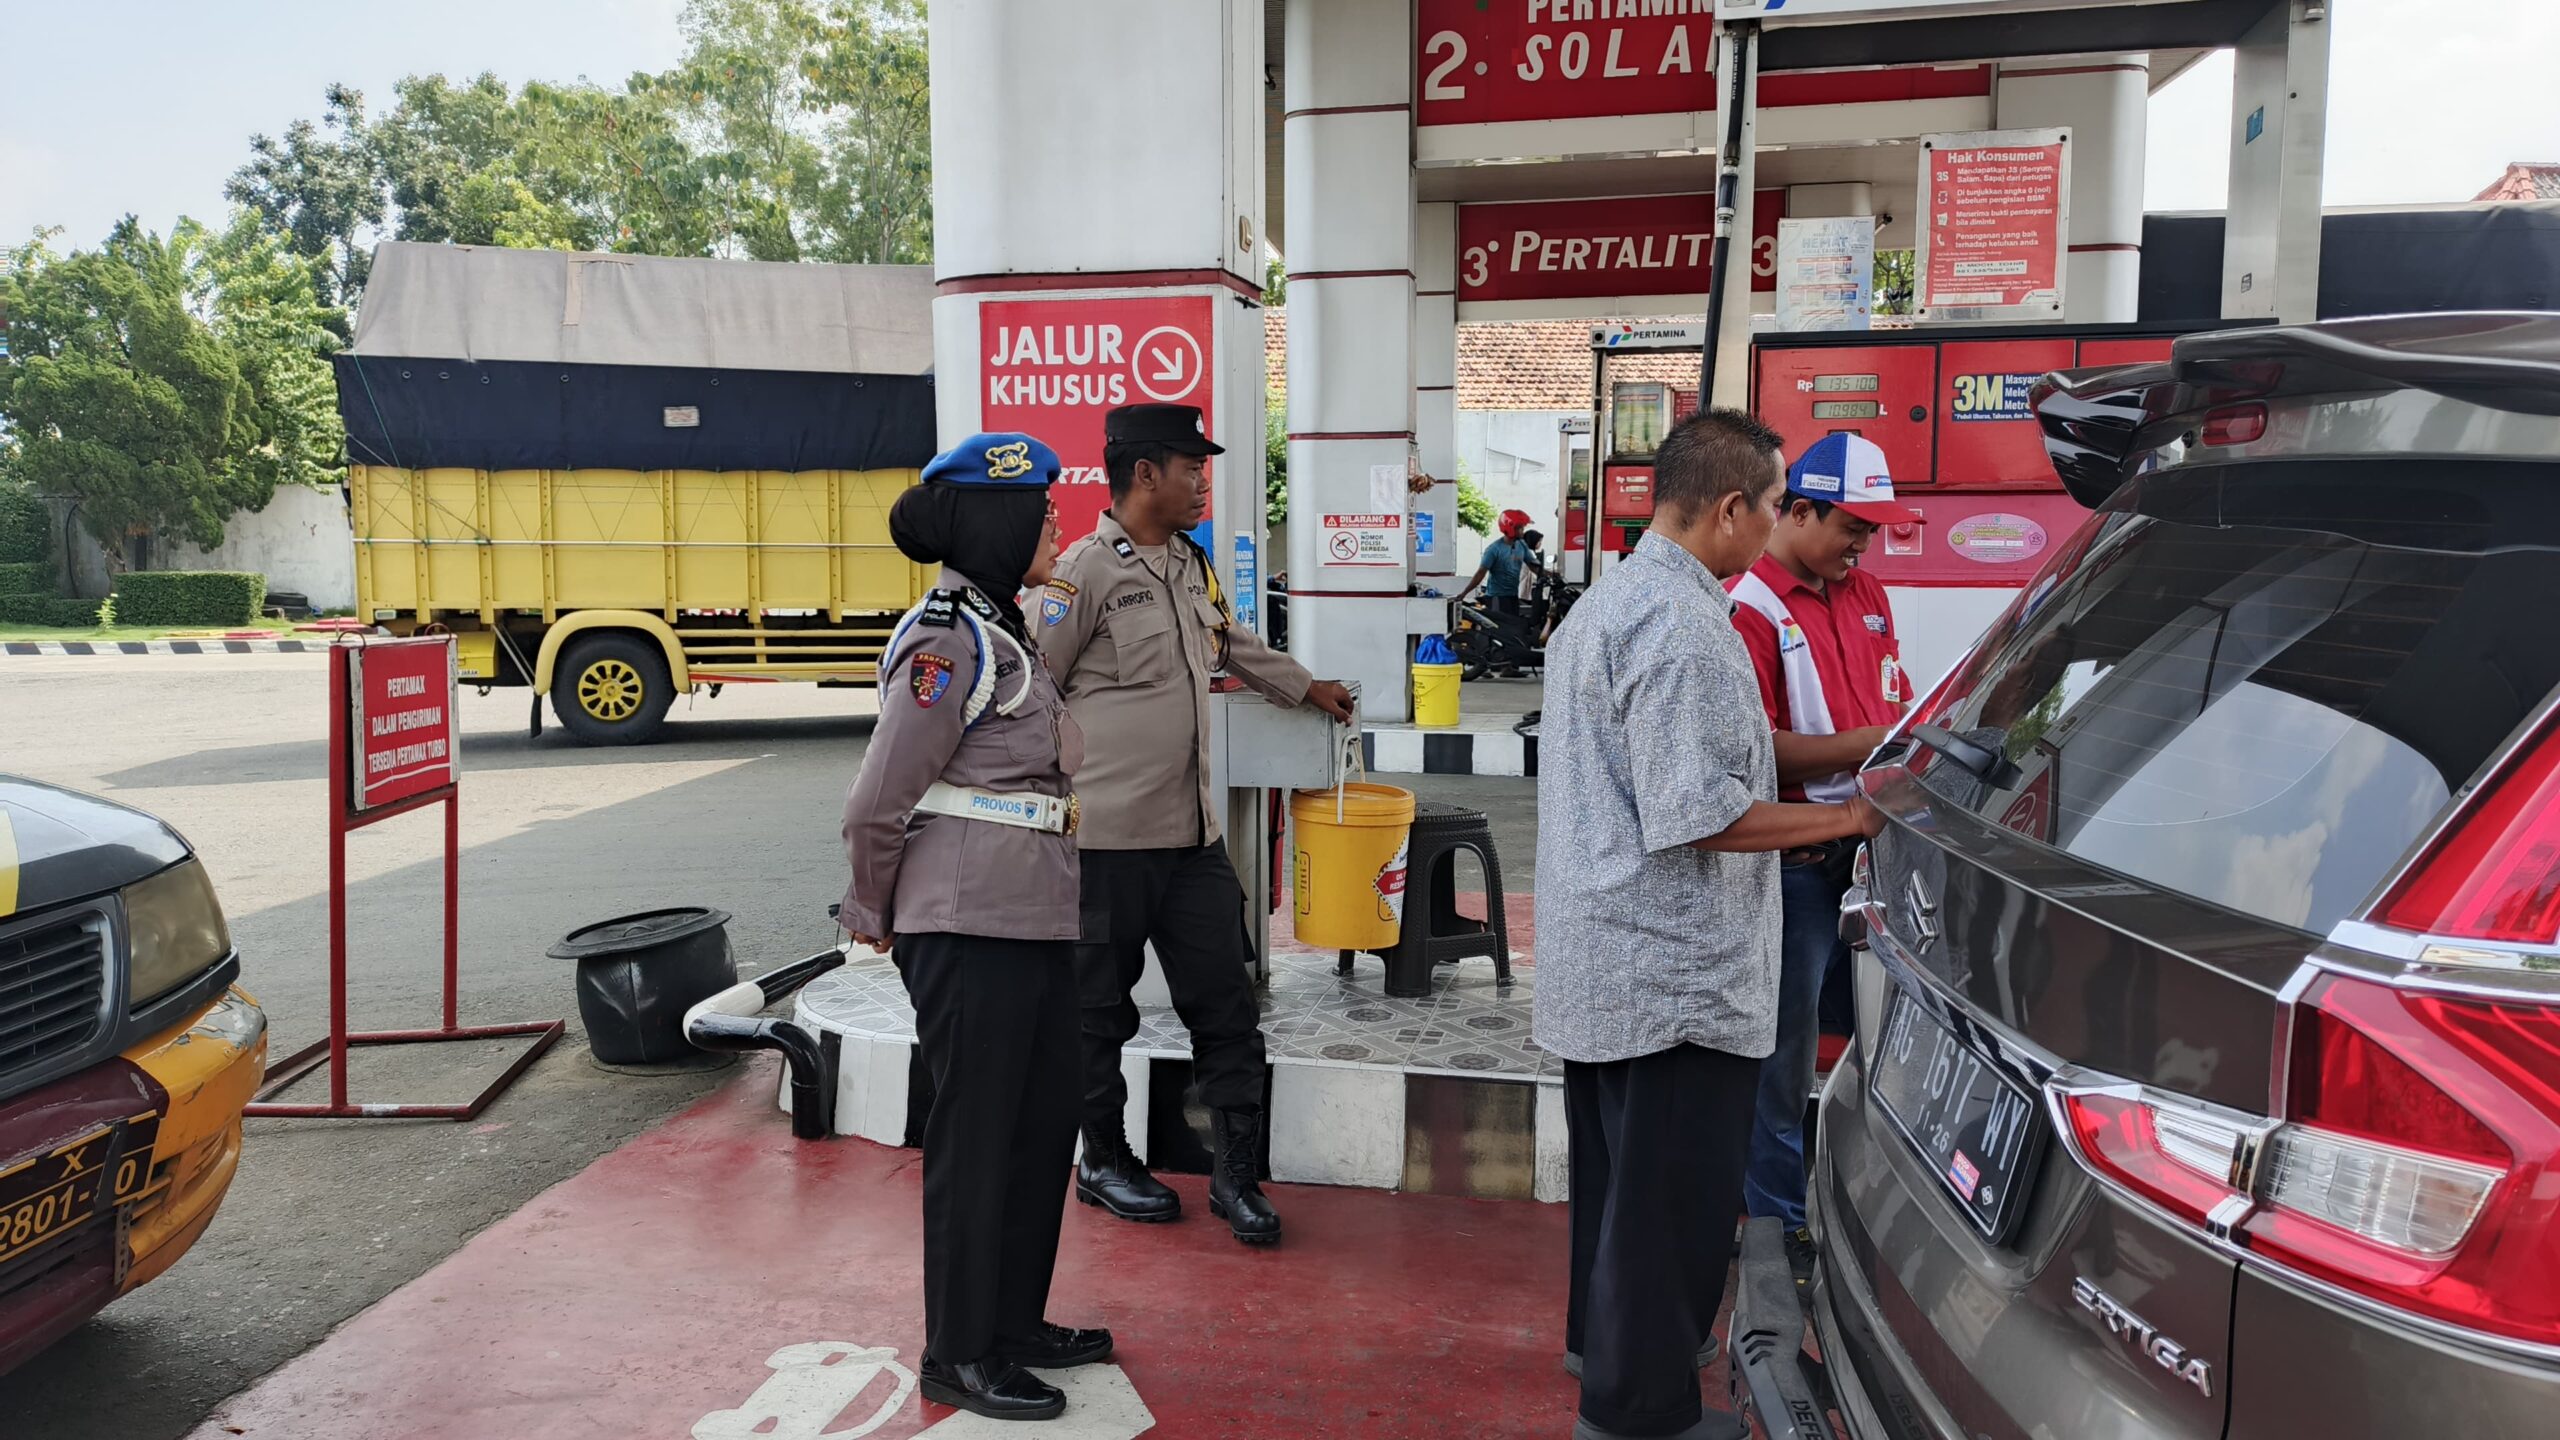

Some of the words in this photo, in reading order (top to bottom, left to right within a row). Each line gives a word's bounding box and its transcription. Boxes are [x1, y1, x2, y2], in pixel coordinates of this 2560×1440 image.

[1517, 25, 1714, 81] SOLA
[1947, 152, 1973, 163] Hak
[1976, 150, 2044, 162] Konsumen
[1936, 171, 1949, 182] 3S
[1509, 230, 1714, 272] PERTALIT
[990, 324, 1126, 367] JALUR
[1633, 329, 1686, 339] PERTAMINA
[990, 373, 1127, 406] KHUSUS
[1797, 379, 1814, 393] Rp
[1953, 375, 2004, 412] 3M
[1880, 403, 1888, 416] L
[1058, 466, 1109, 484] RTA
[1339, 515, 1385, 524] DILARANG
[1104, 602, 1116, 614] A.
[387, 675, 426, 699] PERTAMAX
[372, 712, 397, 737] DALAM
[398, 706, 441, 731] PENGIRIMAN
[368, 749, 396, 774] TERSEDIA
[397, 742, 427, 766] PERTAMAX
[427, 738, 446, 760] TURBO
[972, 796, 1022, 814] PROVOS
[1893, 995, 1922, 1065] AG
[1922, 1026, 1981, 1125] 1617
[1981, 1080, 2027, 1171] WY
[59, 1146, 88, 1180] X
[2072, 1276, 2214, 1397] ERTIGA
[1791, 1400, 1825, 1440] DEFE
